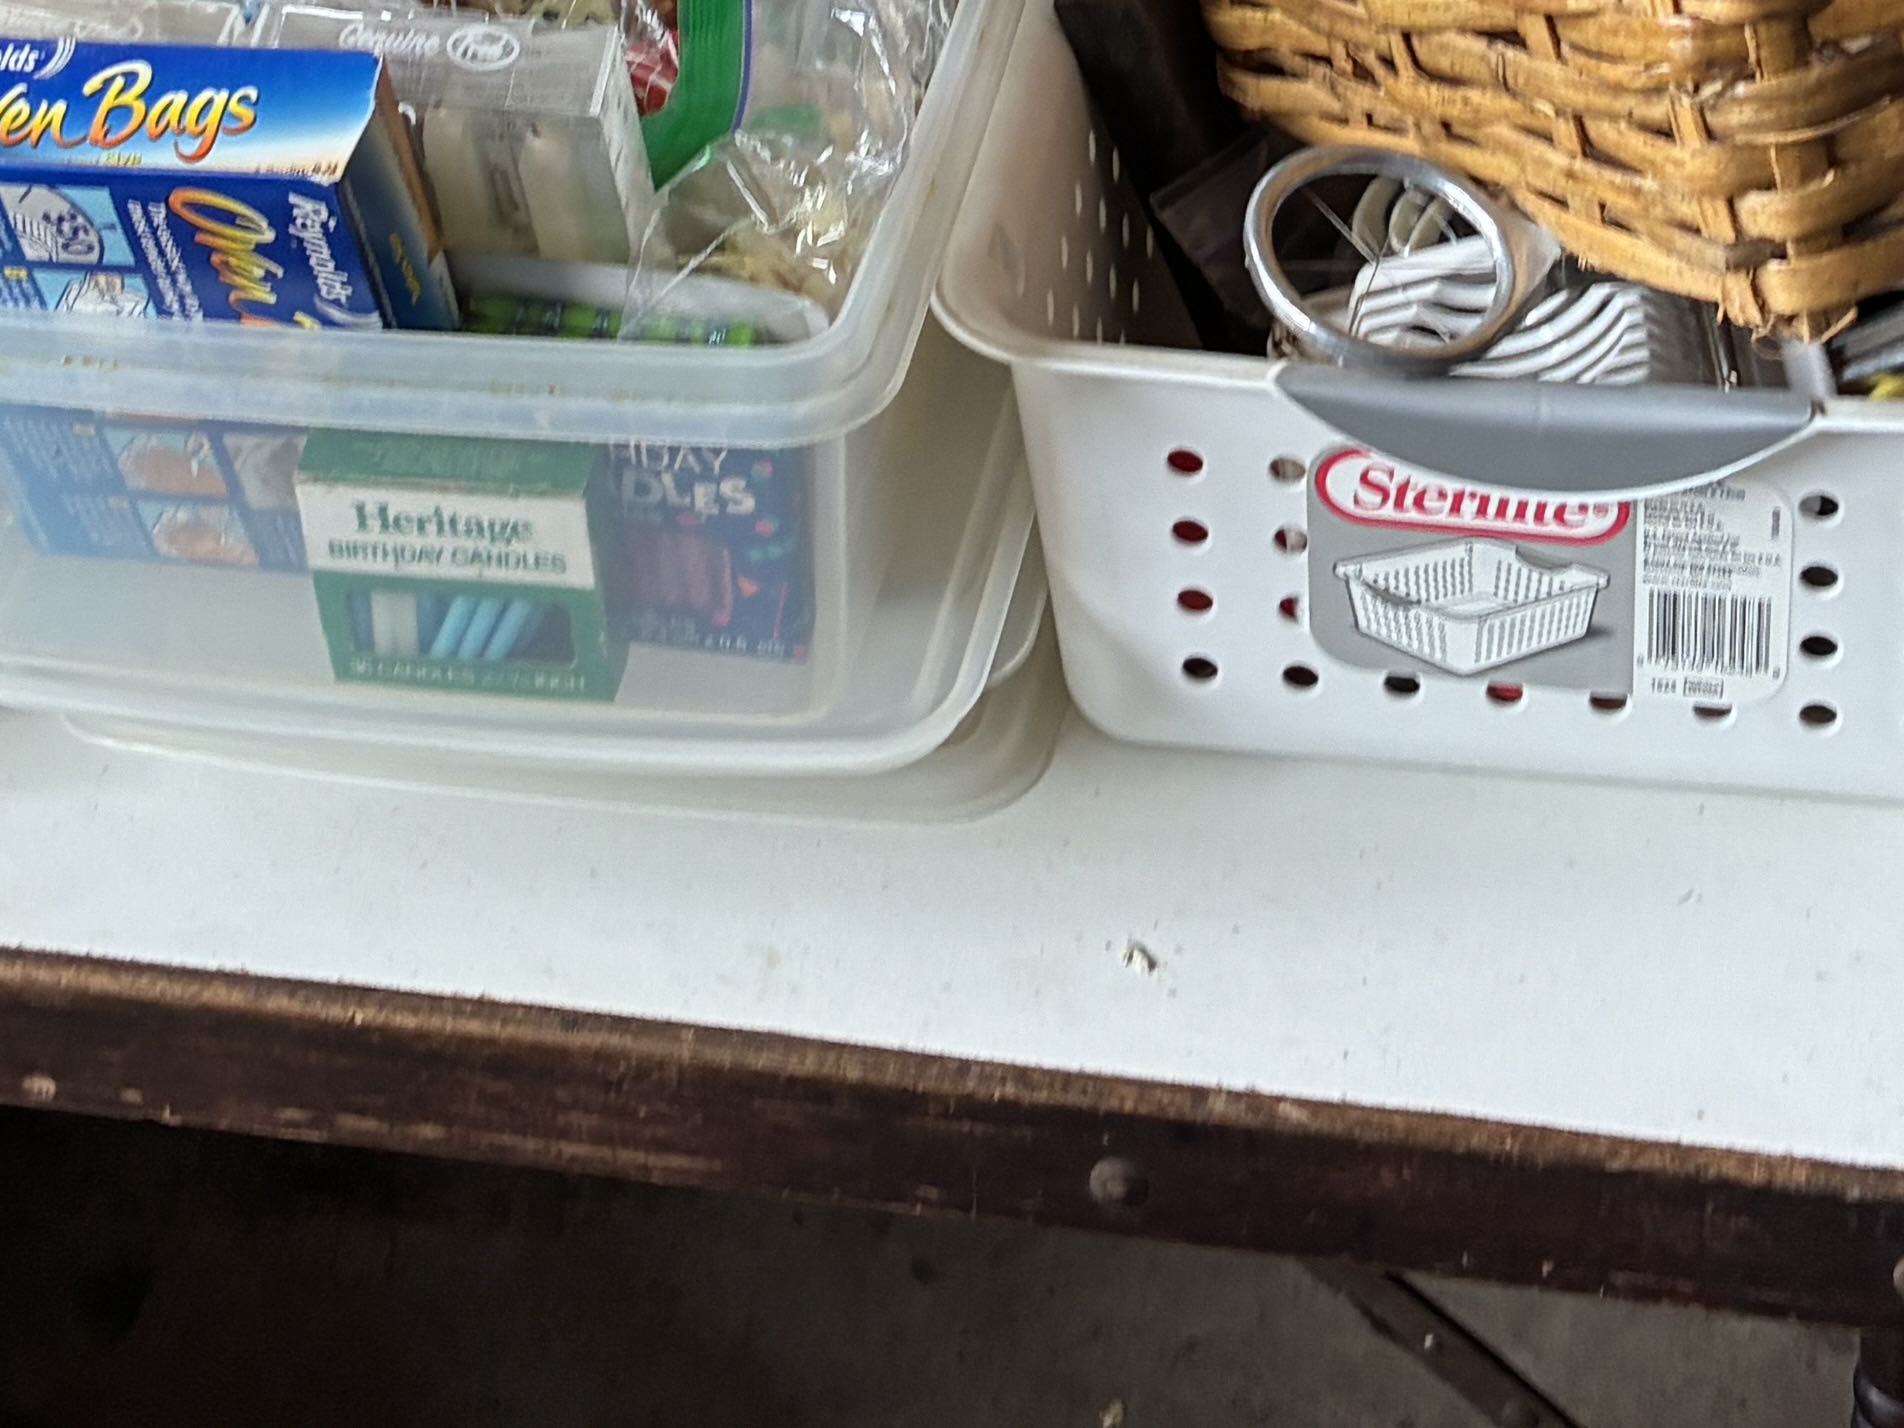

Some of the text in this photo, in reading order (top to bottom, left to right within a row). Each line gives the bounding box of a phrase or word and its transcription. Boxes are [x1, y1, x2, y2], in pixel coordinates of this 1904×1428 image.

[82, 59, 260, 163] Bags
[288, 192, 353, 306] Reynolds
[328, 538, 568, 575] BIRTHDAY CANDLES
[352, 500, 534, 547] Heritage
